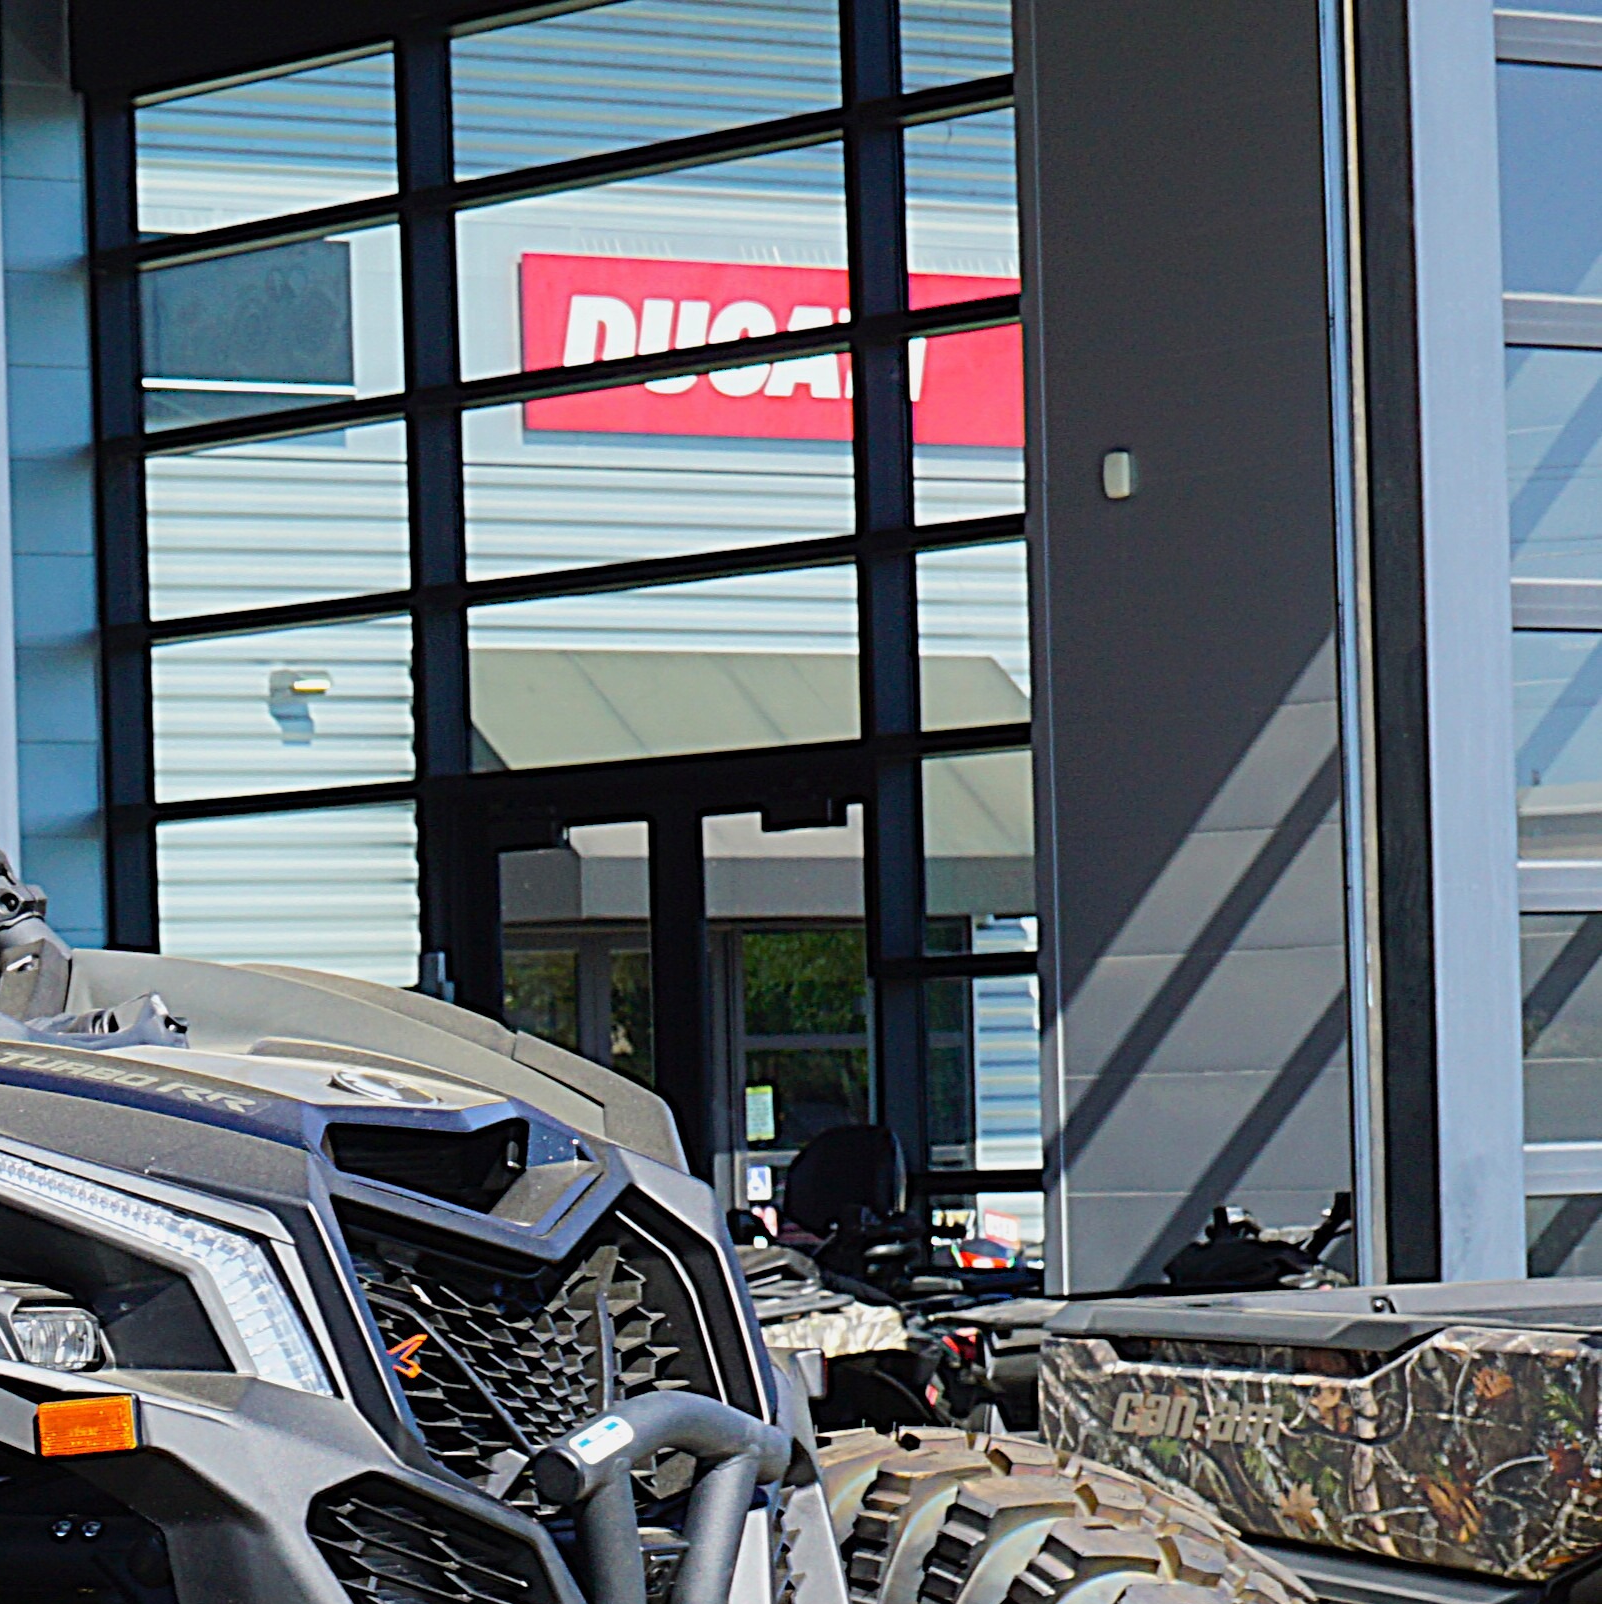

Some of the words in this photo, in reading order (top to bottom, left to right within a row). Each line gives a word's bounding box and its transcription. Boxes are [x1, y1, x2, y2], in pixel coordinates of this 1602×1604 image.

[564, 293, 927, 402] DUCA
[159, 1081, 260, 1114] RR
[1111, 1390, 1286, 1447] can-am
